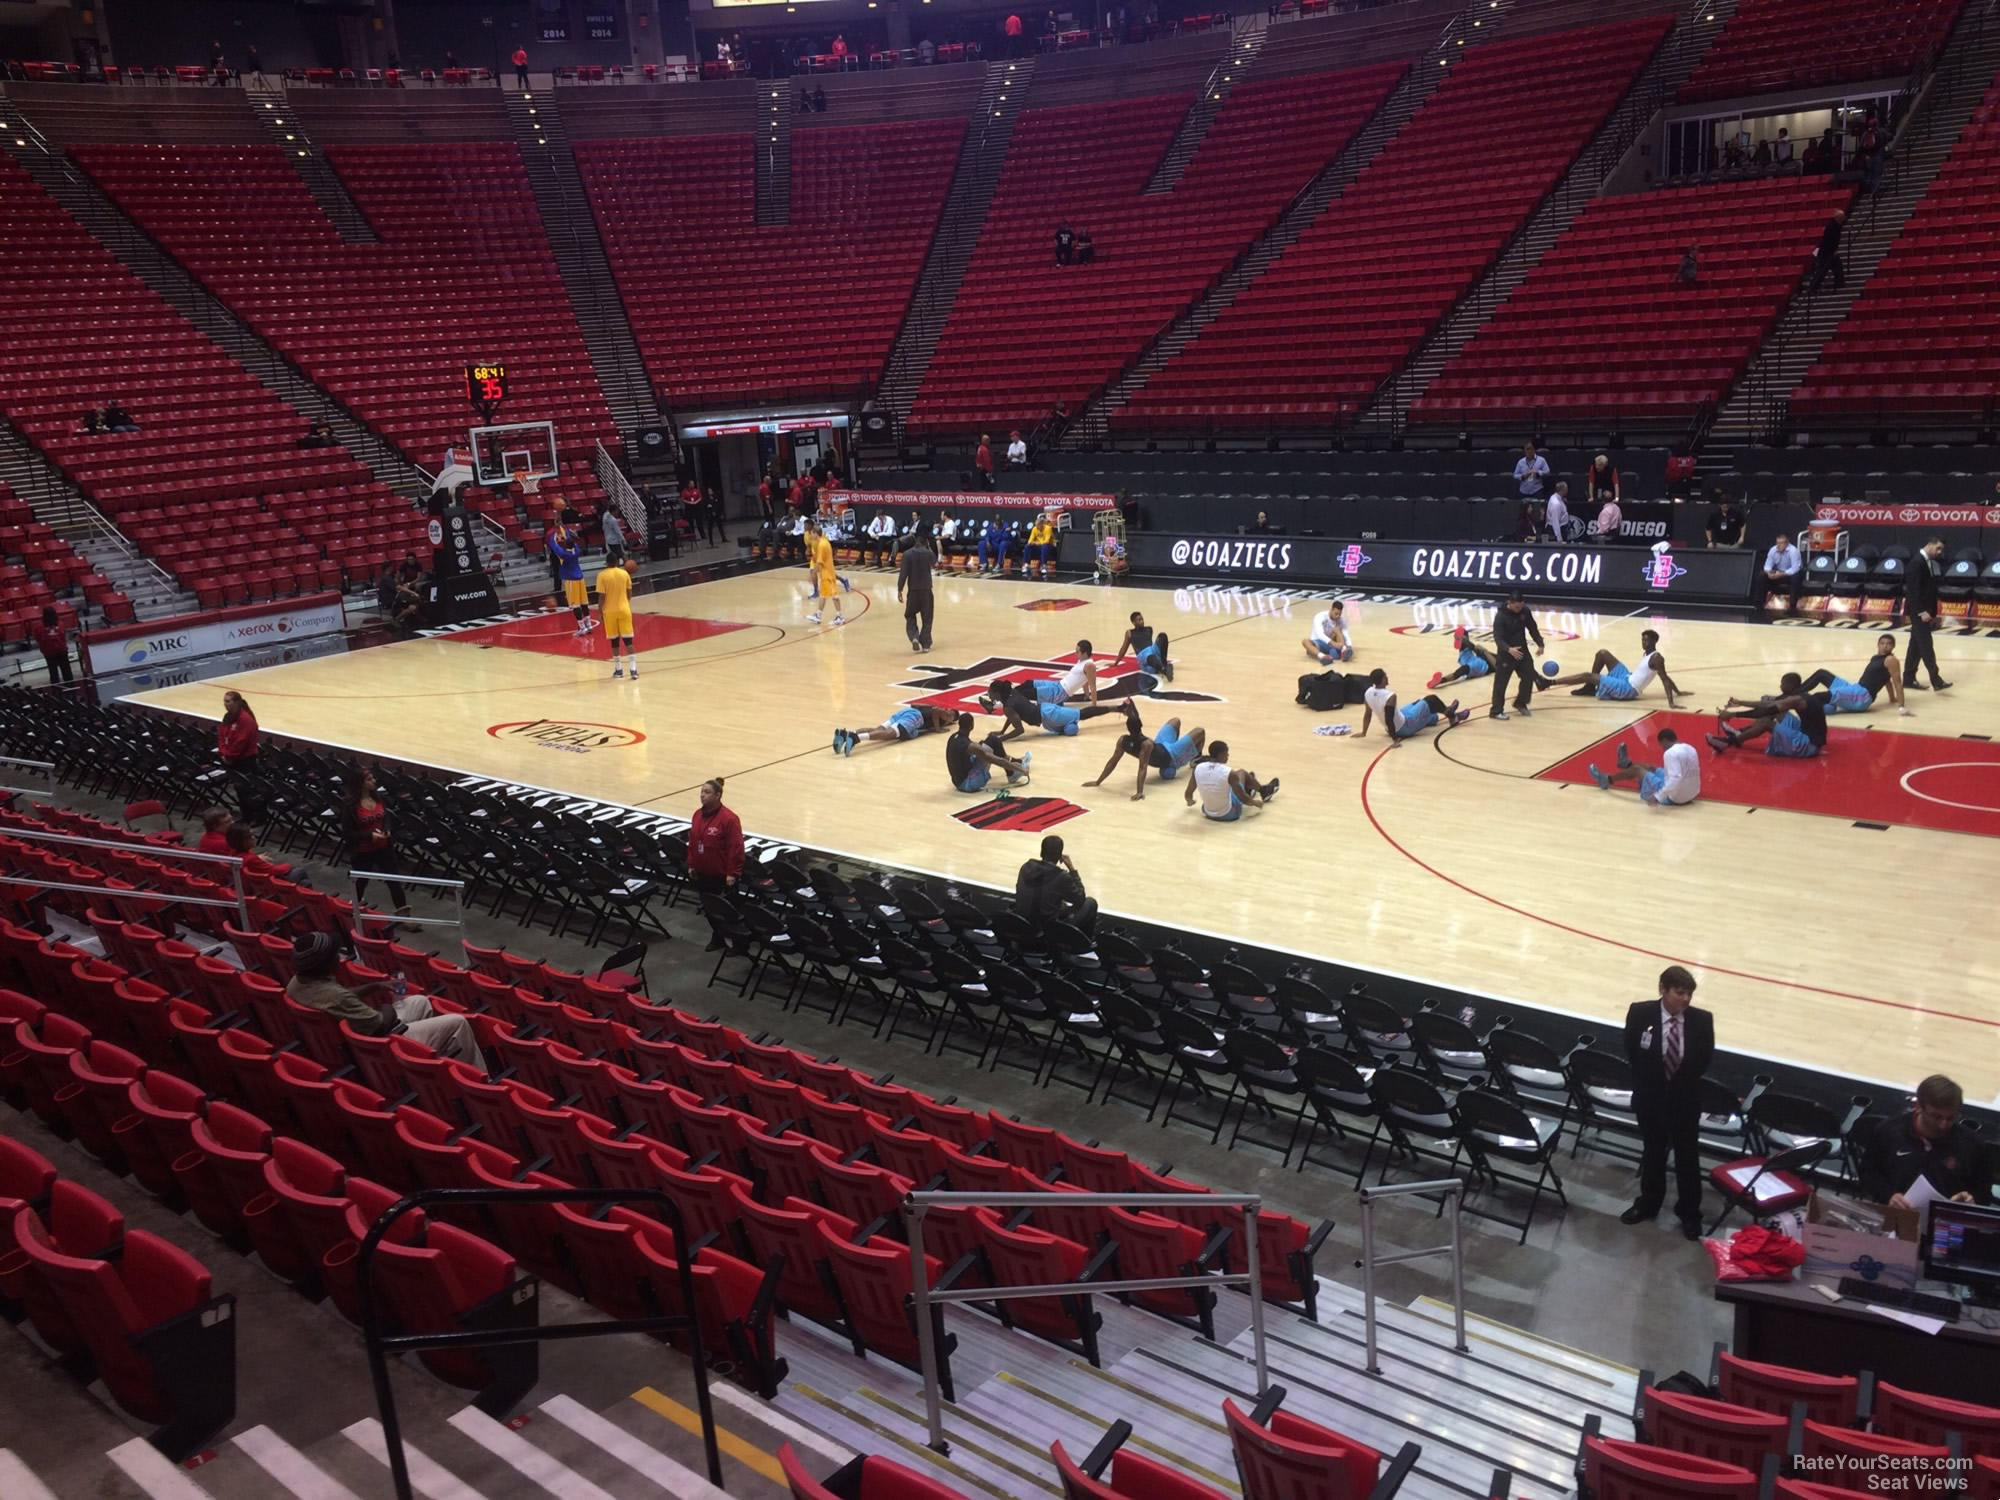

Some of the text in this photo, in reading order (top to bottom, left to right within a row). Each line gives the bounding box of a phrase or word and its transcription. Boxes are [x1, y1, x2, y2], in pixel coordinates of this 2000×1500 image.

[543, 29, 565, 38] 2014
[591, 29, 612, 37] 2014
[474, 367, 504, 380] 68:41
[481, 379, 503, 399] 35
[860, 494, 884, 502] TOYOTA
[894, 495, 918, 503] TOYOTA
[966, 496, 991, 504] TOYOTA
[1004, 497, 1030, 505] TOYOTA
[1043, 497, 1071, 505] TOYOTA
[1085, 498, 1114, 507] TOYOTA
[1840, 509, 1979, 521] TOYOTA TOYOTA
[1619, 520, 1667, 537] DIEGO
[1171, 539, 1292, 570] @GOAZTECS
[1412, 548, 1602, 584] GOAZTECS.COM
[454, 590, 487, 602] vw.com
[1256, 587, 1365, 603] DIEGO
[1371, 593, 1496, 609] STATE
[227, 614, 337, 639] A xerox Company
[148, 635, 188, 654] MRC
